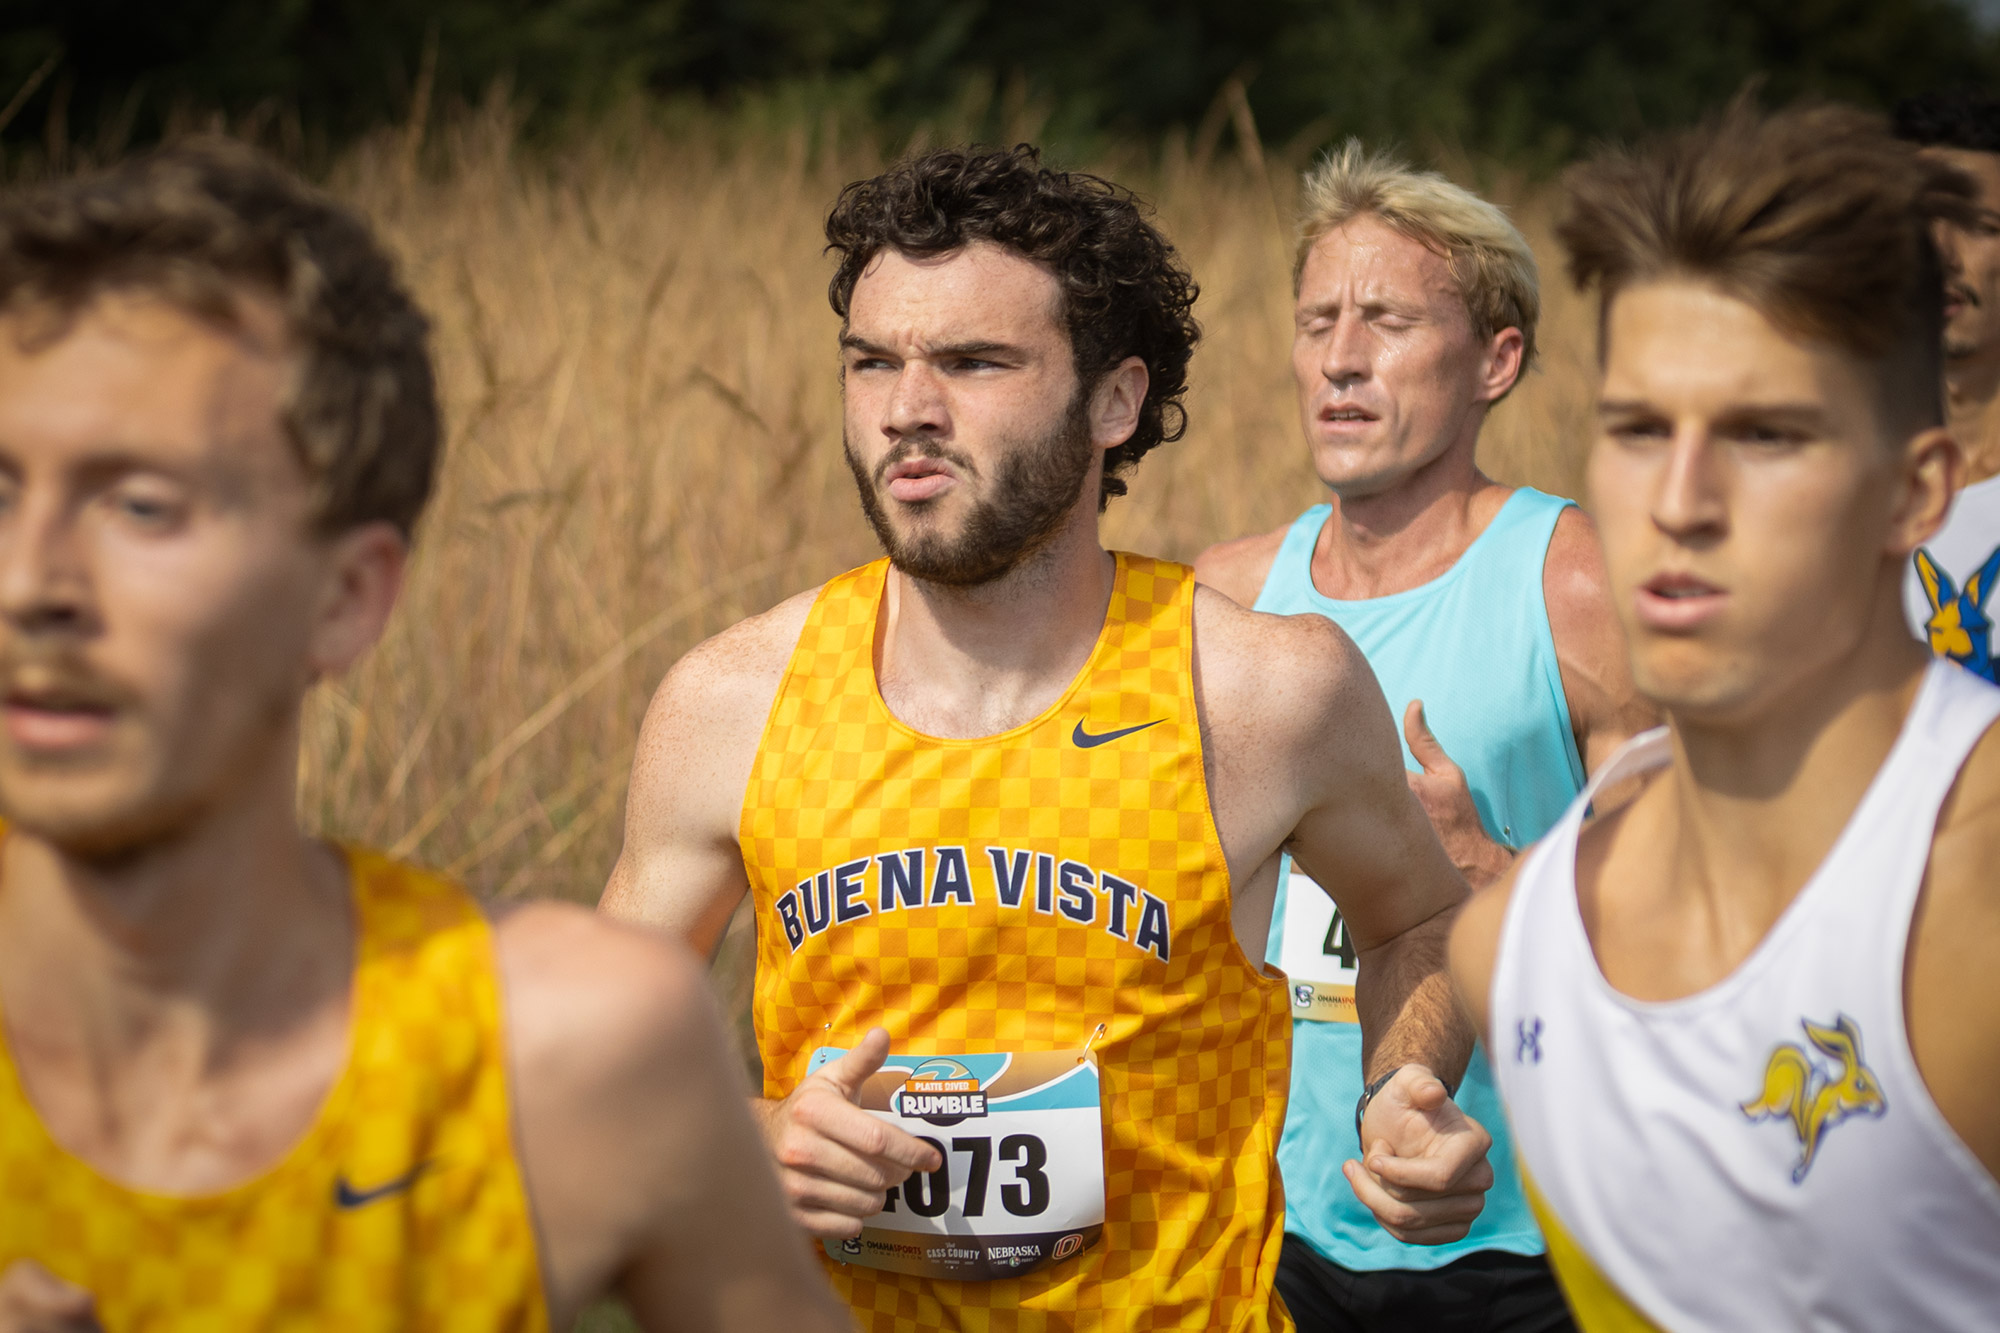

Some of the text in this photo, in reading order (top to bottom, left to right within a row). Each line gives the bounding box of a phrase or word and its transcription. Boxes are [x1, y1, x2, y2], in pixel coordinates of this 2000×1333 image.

[776, 846, 1170, 963] BUENA VISTA
[1323, 906, 1356, 969] 4
[915, 1082, 970, 1091] PLATTE RIVER
[902, 1095, 985, 1115] RUMBLE
[882, 1134, 1050, 1217] 073
[926, 1248, 980, 1260] CASS COUNTY
[987, 1245, 1041, 1260] NEBRASKA
